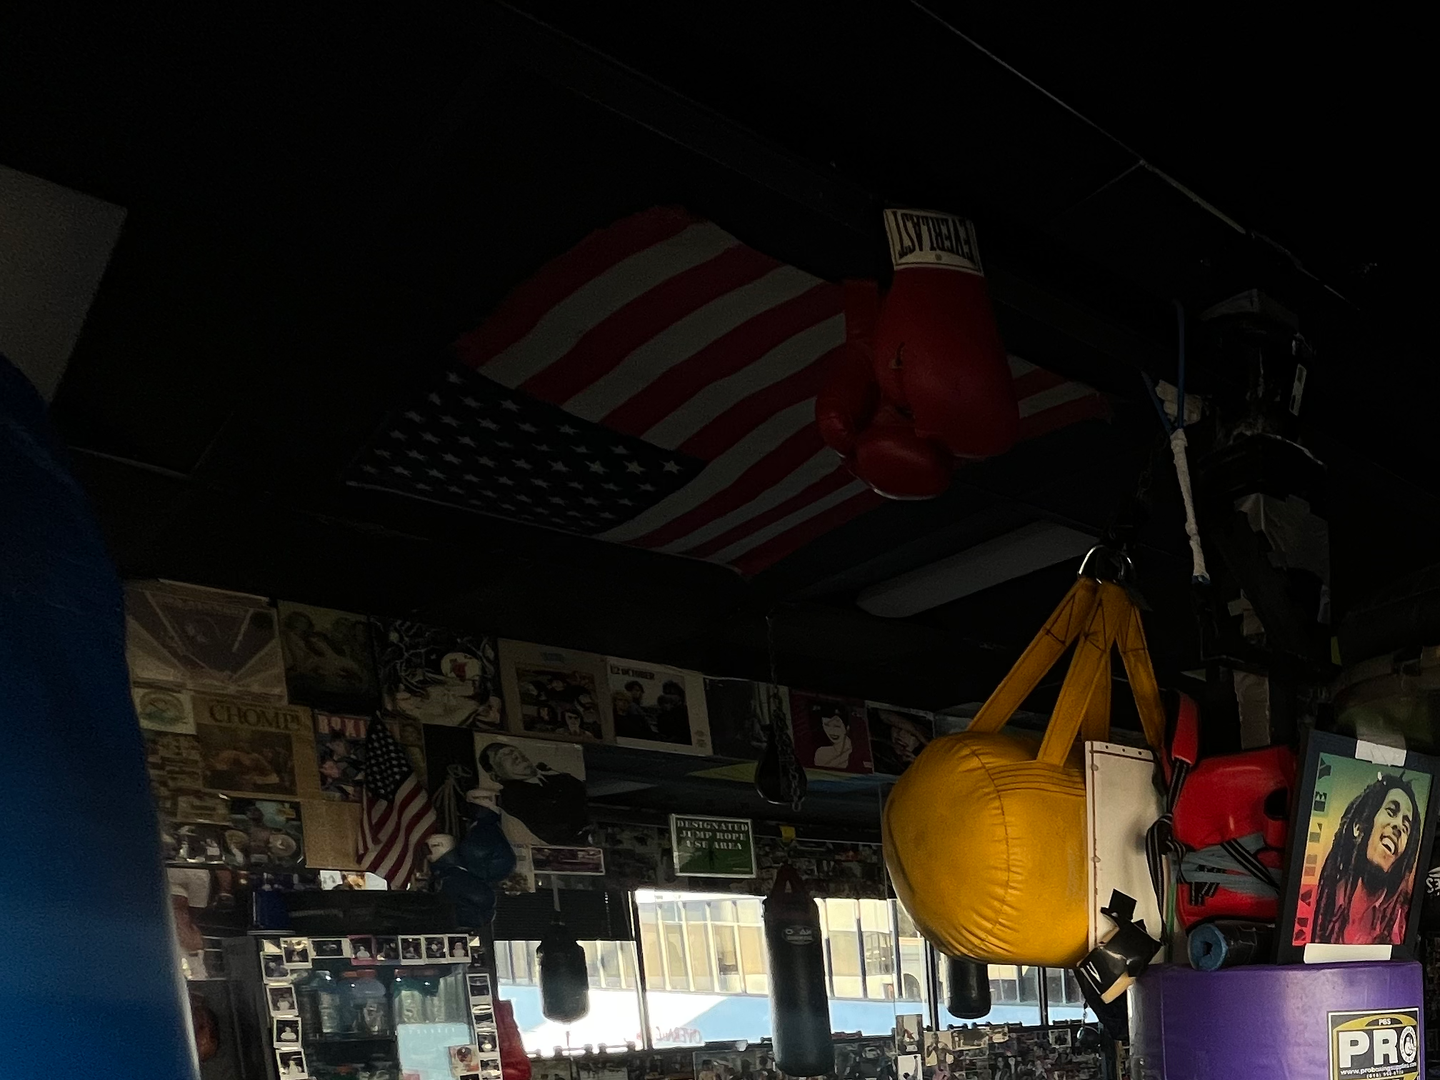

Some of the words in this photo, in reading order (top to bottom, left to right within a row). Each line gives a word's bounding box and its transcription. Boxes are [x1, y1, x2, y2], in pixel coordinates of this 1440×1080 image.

[892, 210, 976, 264] EVERLAST
[676, 820, 749, 832] DESIGNATED
[680, 829, 713, 839] JUMP
[716, 831, 747, 841] ROPE
[686, 840, 709, 849] USE
[713, 841, 743, 850] AREA
[1294, 757, 1332, 942] MARLEY
[1338, 1026, 1417, 1069] PRO
